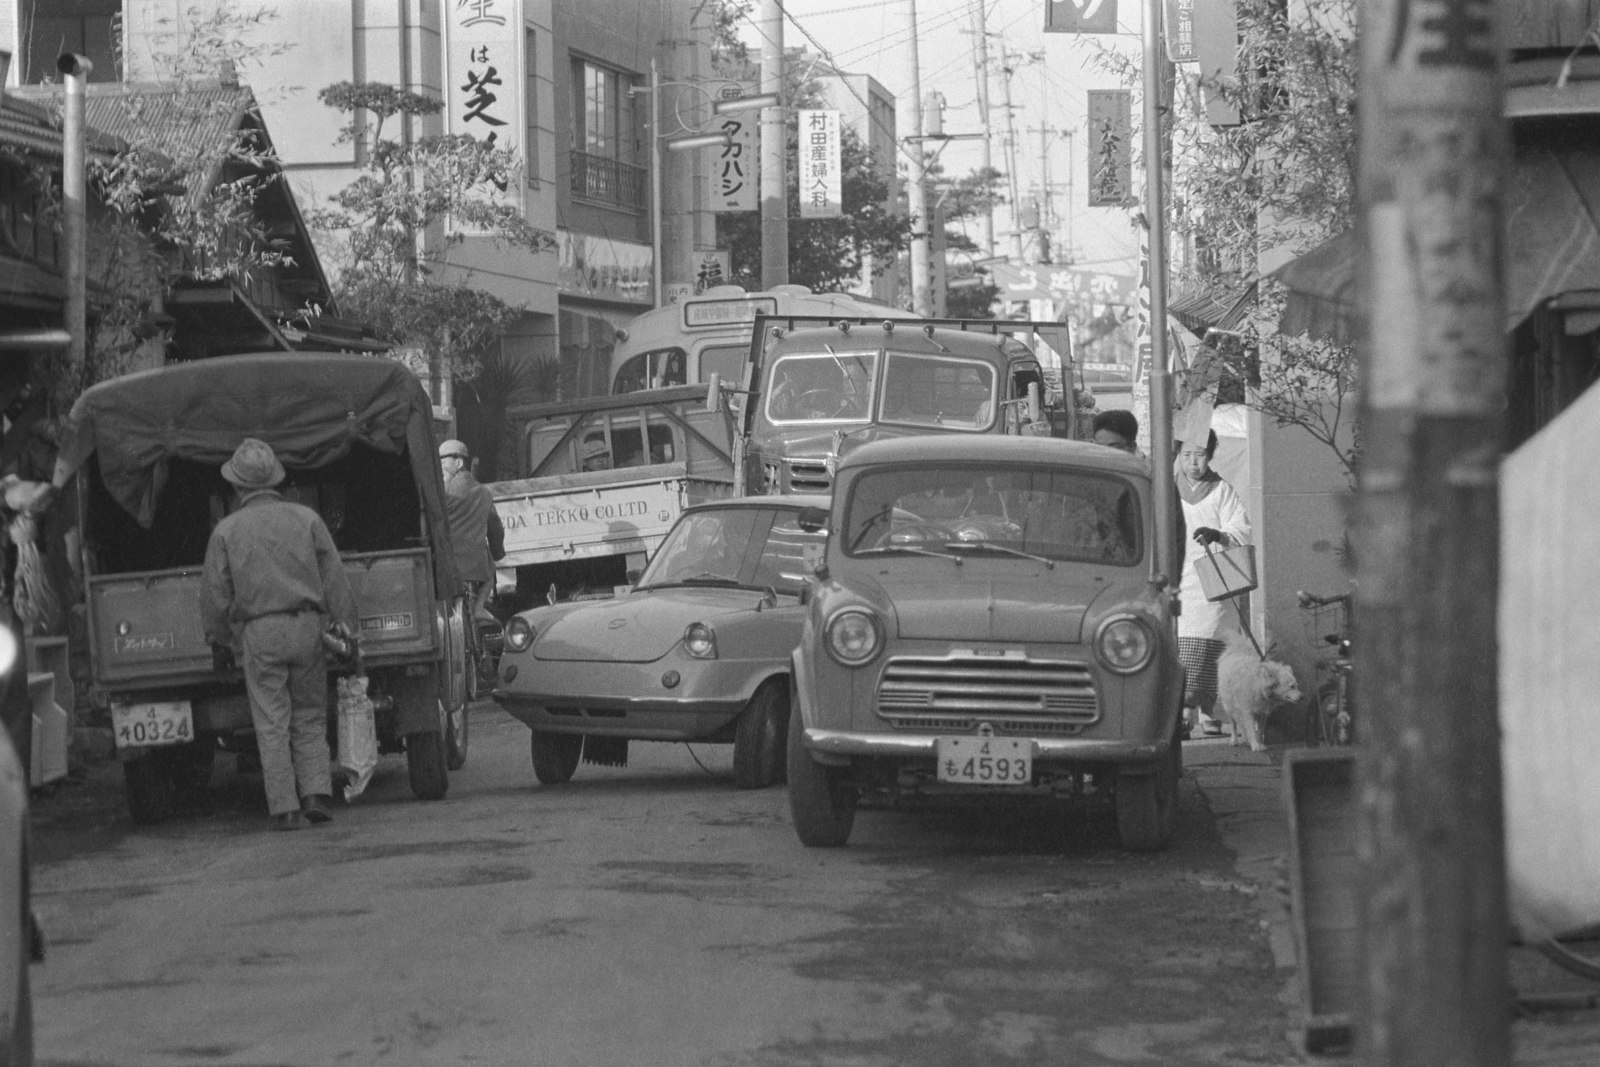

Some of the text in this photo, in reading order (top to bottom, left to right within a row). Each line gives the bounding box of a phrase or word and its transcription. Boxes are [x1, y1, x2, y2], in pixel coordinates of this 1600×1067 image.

[721, 120, 743, 196] タカハシ
[809, 112, 828, 207] 村田産婦人科
[147, 707, 156, 718] 4
[981, 742, 990, 754] 4
